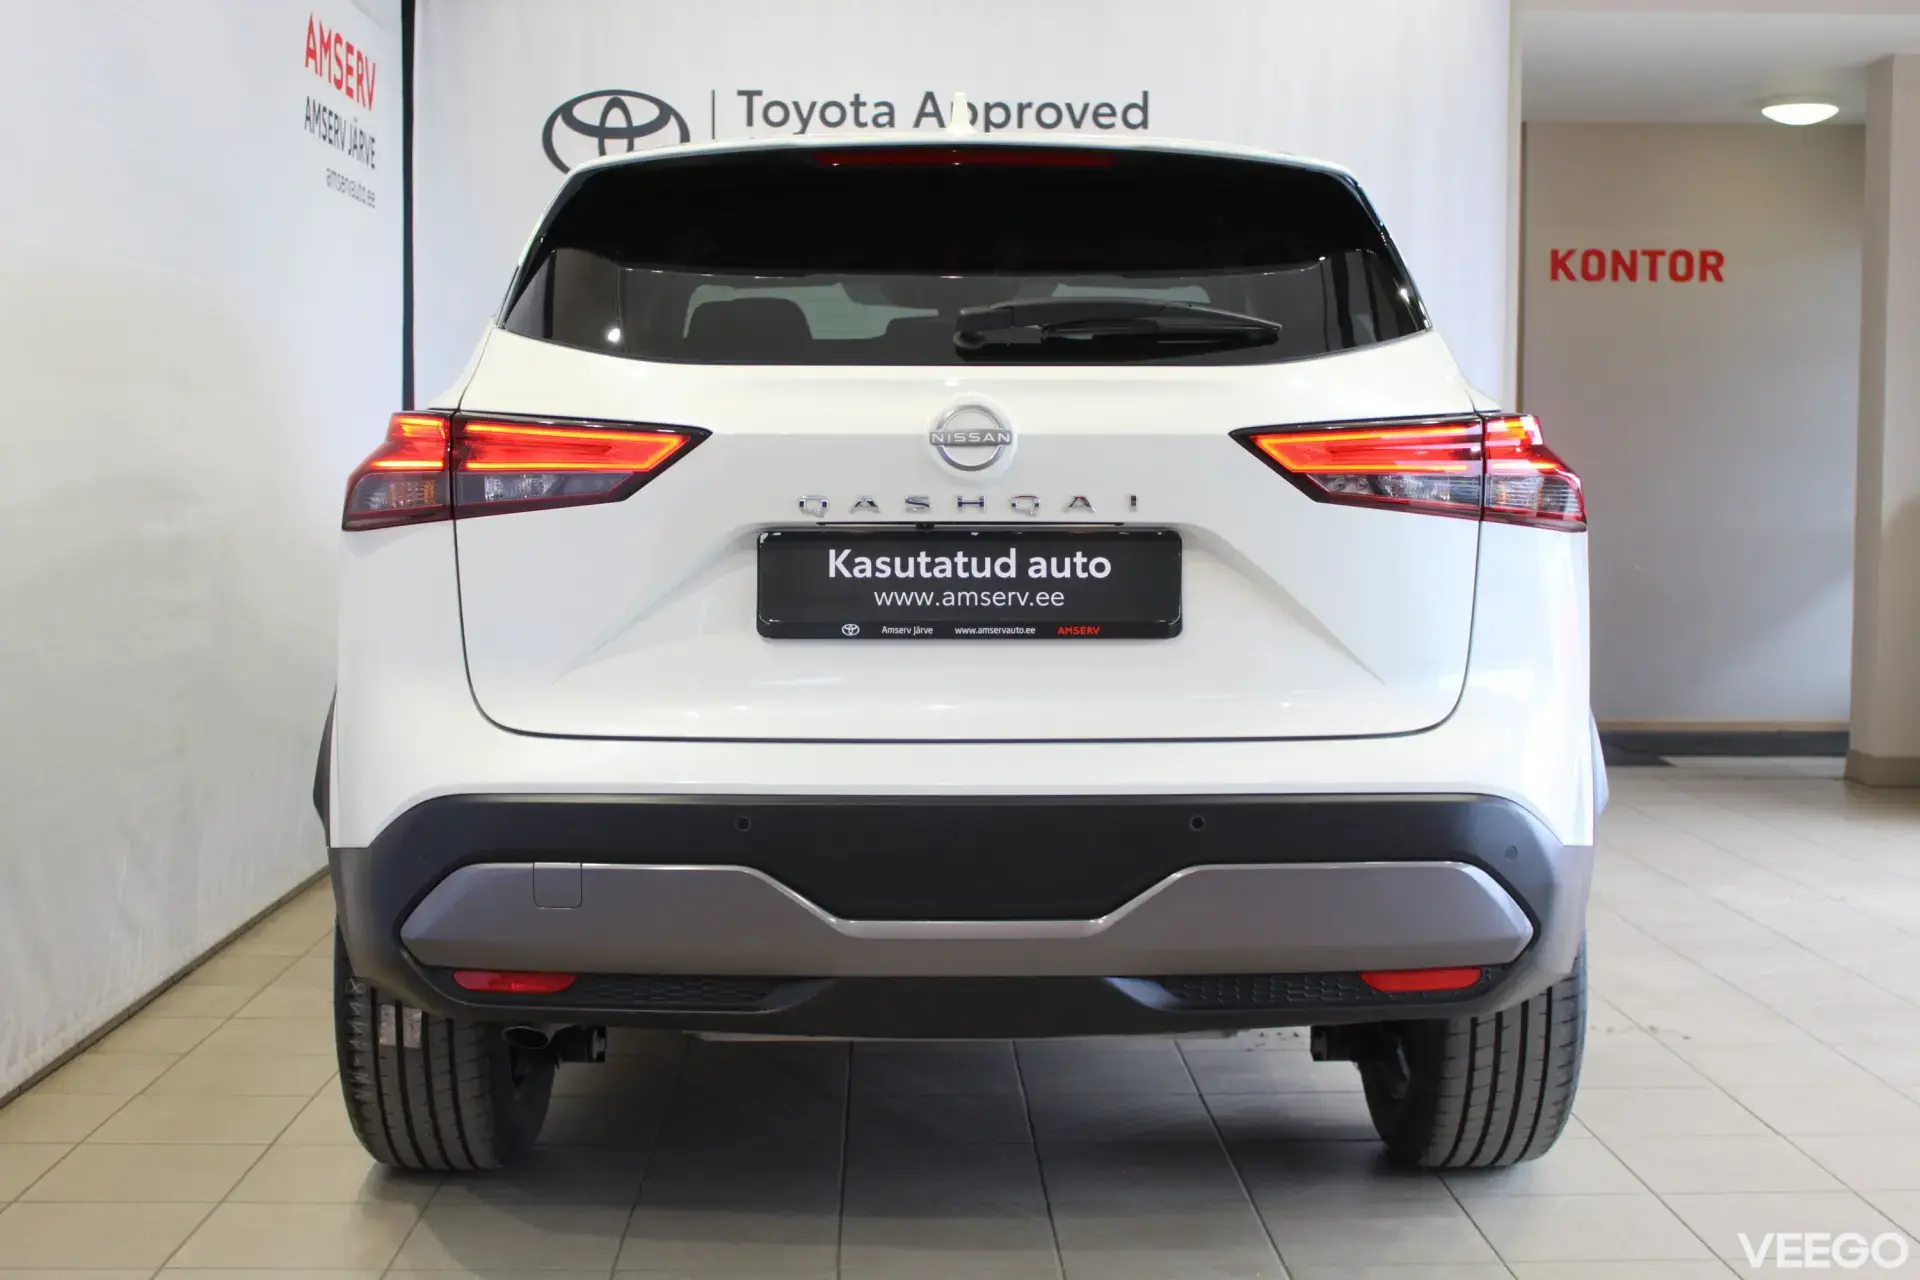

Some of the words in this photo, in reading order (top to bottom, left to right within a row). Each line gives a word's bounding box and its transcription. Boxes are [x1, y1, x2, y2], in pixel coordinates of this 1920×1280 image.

[304, 12, 376, 111] AMSERV
[737, 90, 895, 135] Toyota
[304, 96, 347, 152] AMSERV
[348, 116, 376, 170] JÄRVE
[1550, 248, 1725, 282] KONTOR
[931, 431, 1011, 444] NISSAN
[798, 495, 1139, 517] QASHQAI
[828, 548, 1017, 579] Kasutatud
[1028, 552, 1112, 579] auto
[873, 589, 1065, 607] www.amserv.ee
[881, 625, 912, 635] Amserv
[913, 625, 934, 636] Järve
[954, 626, 1036, 635] www.amservauto.ee
[1057, 626, 1101, 635] AMSERV
